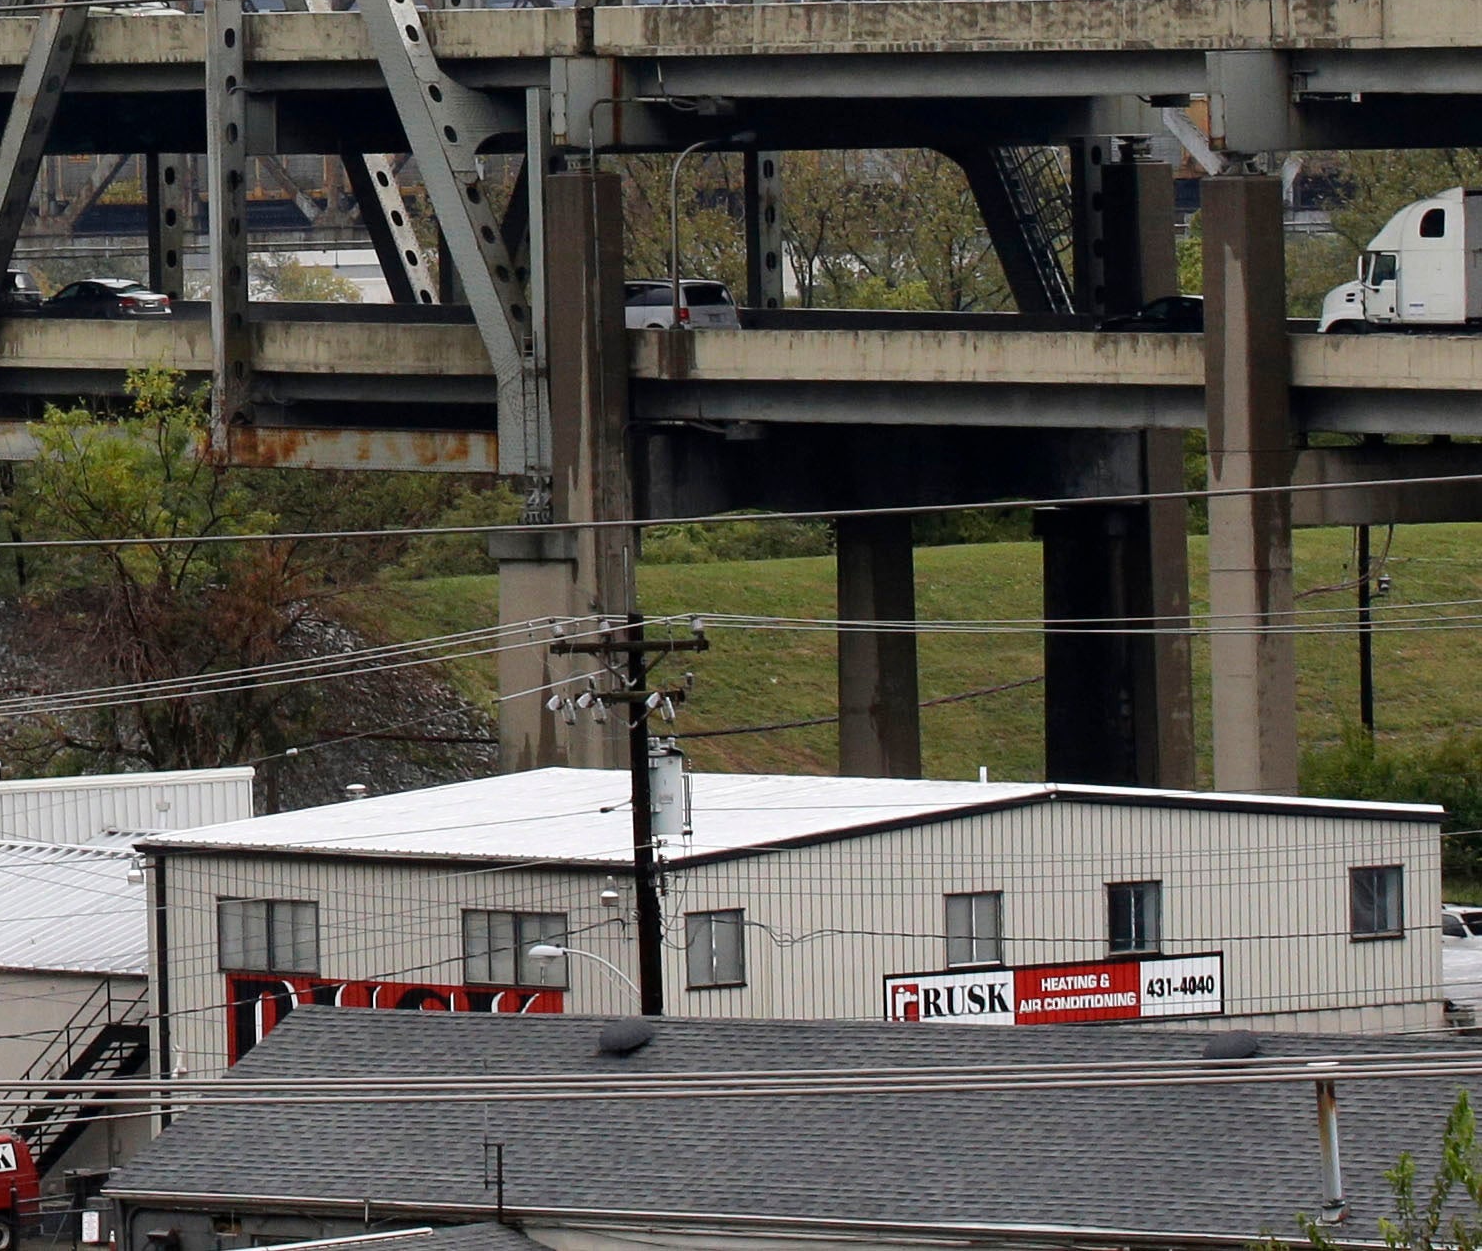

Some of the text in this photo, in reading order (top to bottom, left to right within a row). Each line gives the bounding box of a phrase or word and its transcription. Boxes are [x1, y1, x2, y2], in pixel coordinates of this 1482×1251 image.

[1041, 973, 1111, 992] HEATING &
[1146, 974, 1215, 998] 431-4040
[921, 982, 1010, 1018] RUSK
[1019, 991, 1137, 1014] AIR CONDITIONING
